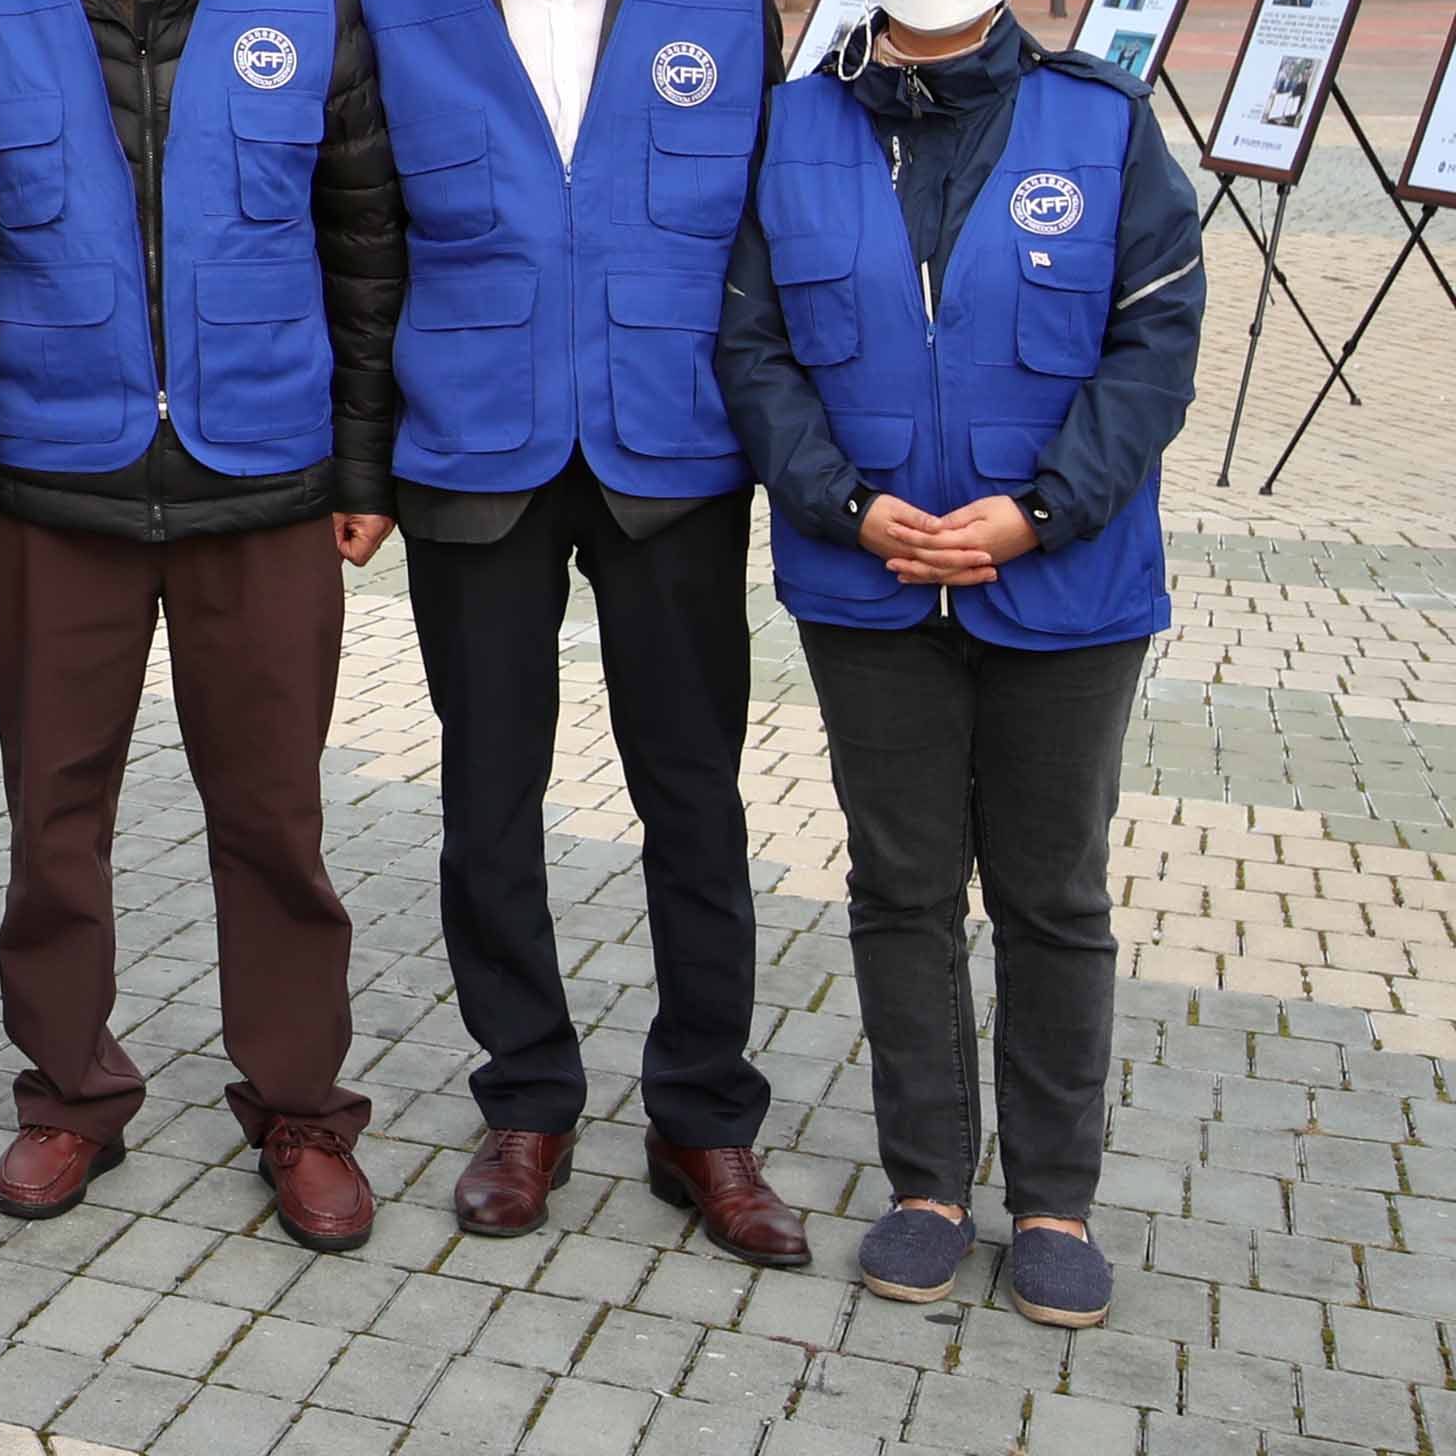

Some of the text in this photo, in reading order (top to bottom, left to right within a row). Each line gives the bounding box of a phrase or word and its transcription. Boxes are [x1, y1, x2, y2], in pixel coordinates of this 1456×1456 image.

[247, 51, 286, 69] KFF
[667, 65, 705, 85] KFF
[1025, 196, 1069, 215] KFF
